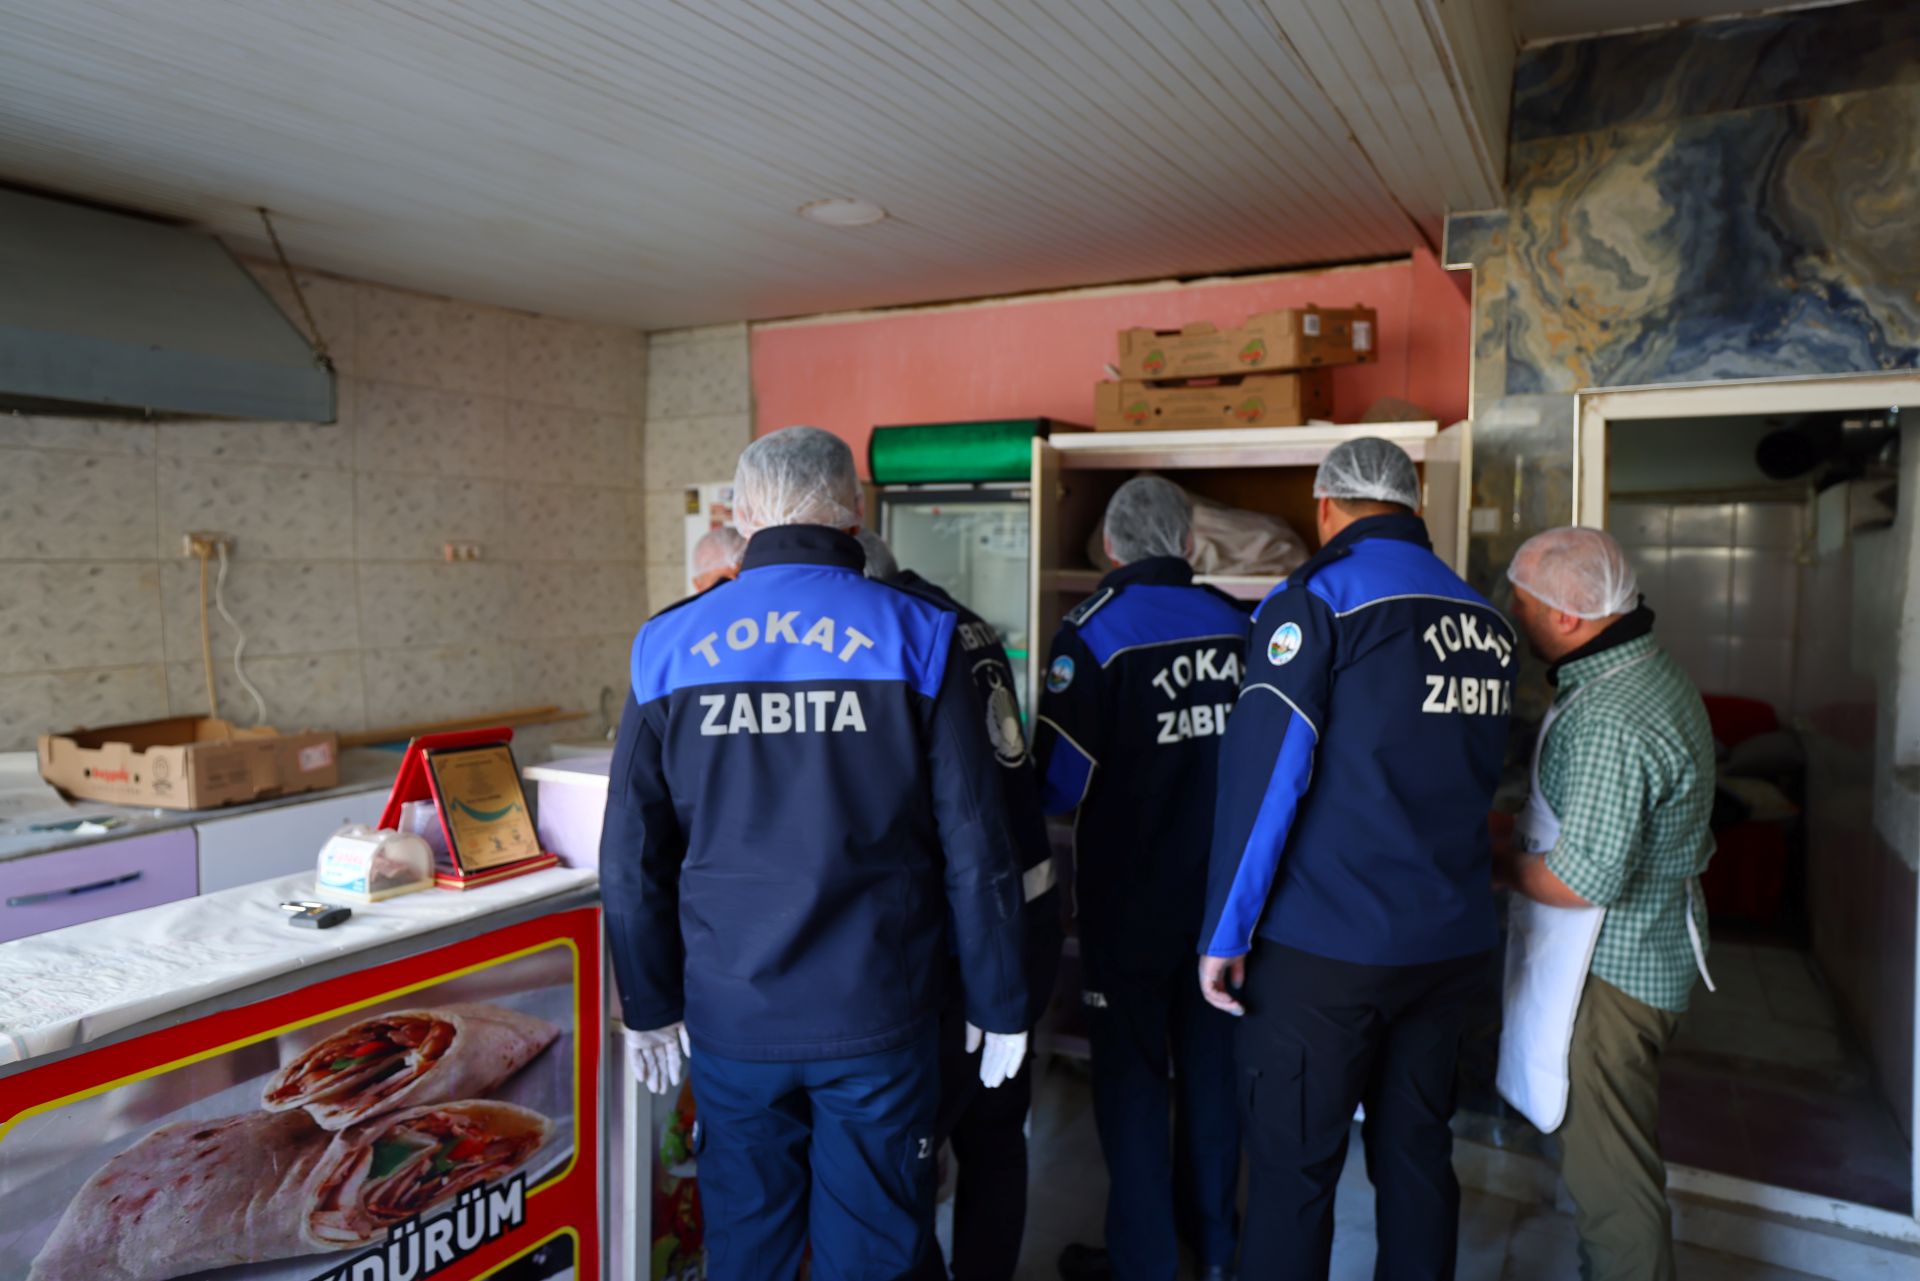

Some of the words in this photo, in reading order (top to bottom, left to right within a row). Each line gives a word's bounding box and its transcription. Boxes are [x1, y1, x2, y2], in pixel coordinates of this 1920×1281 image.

[690, 611, 874, 668] TOKAT
[1152, 647, 1246, 700] TOKA
[1422, 674, 1511, 716] ZABITA
[699, 690, 867, 736] ZABITA
[1157, 702, 1232, 744] ZABI
